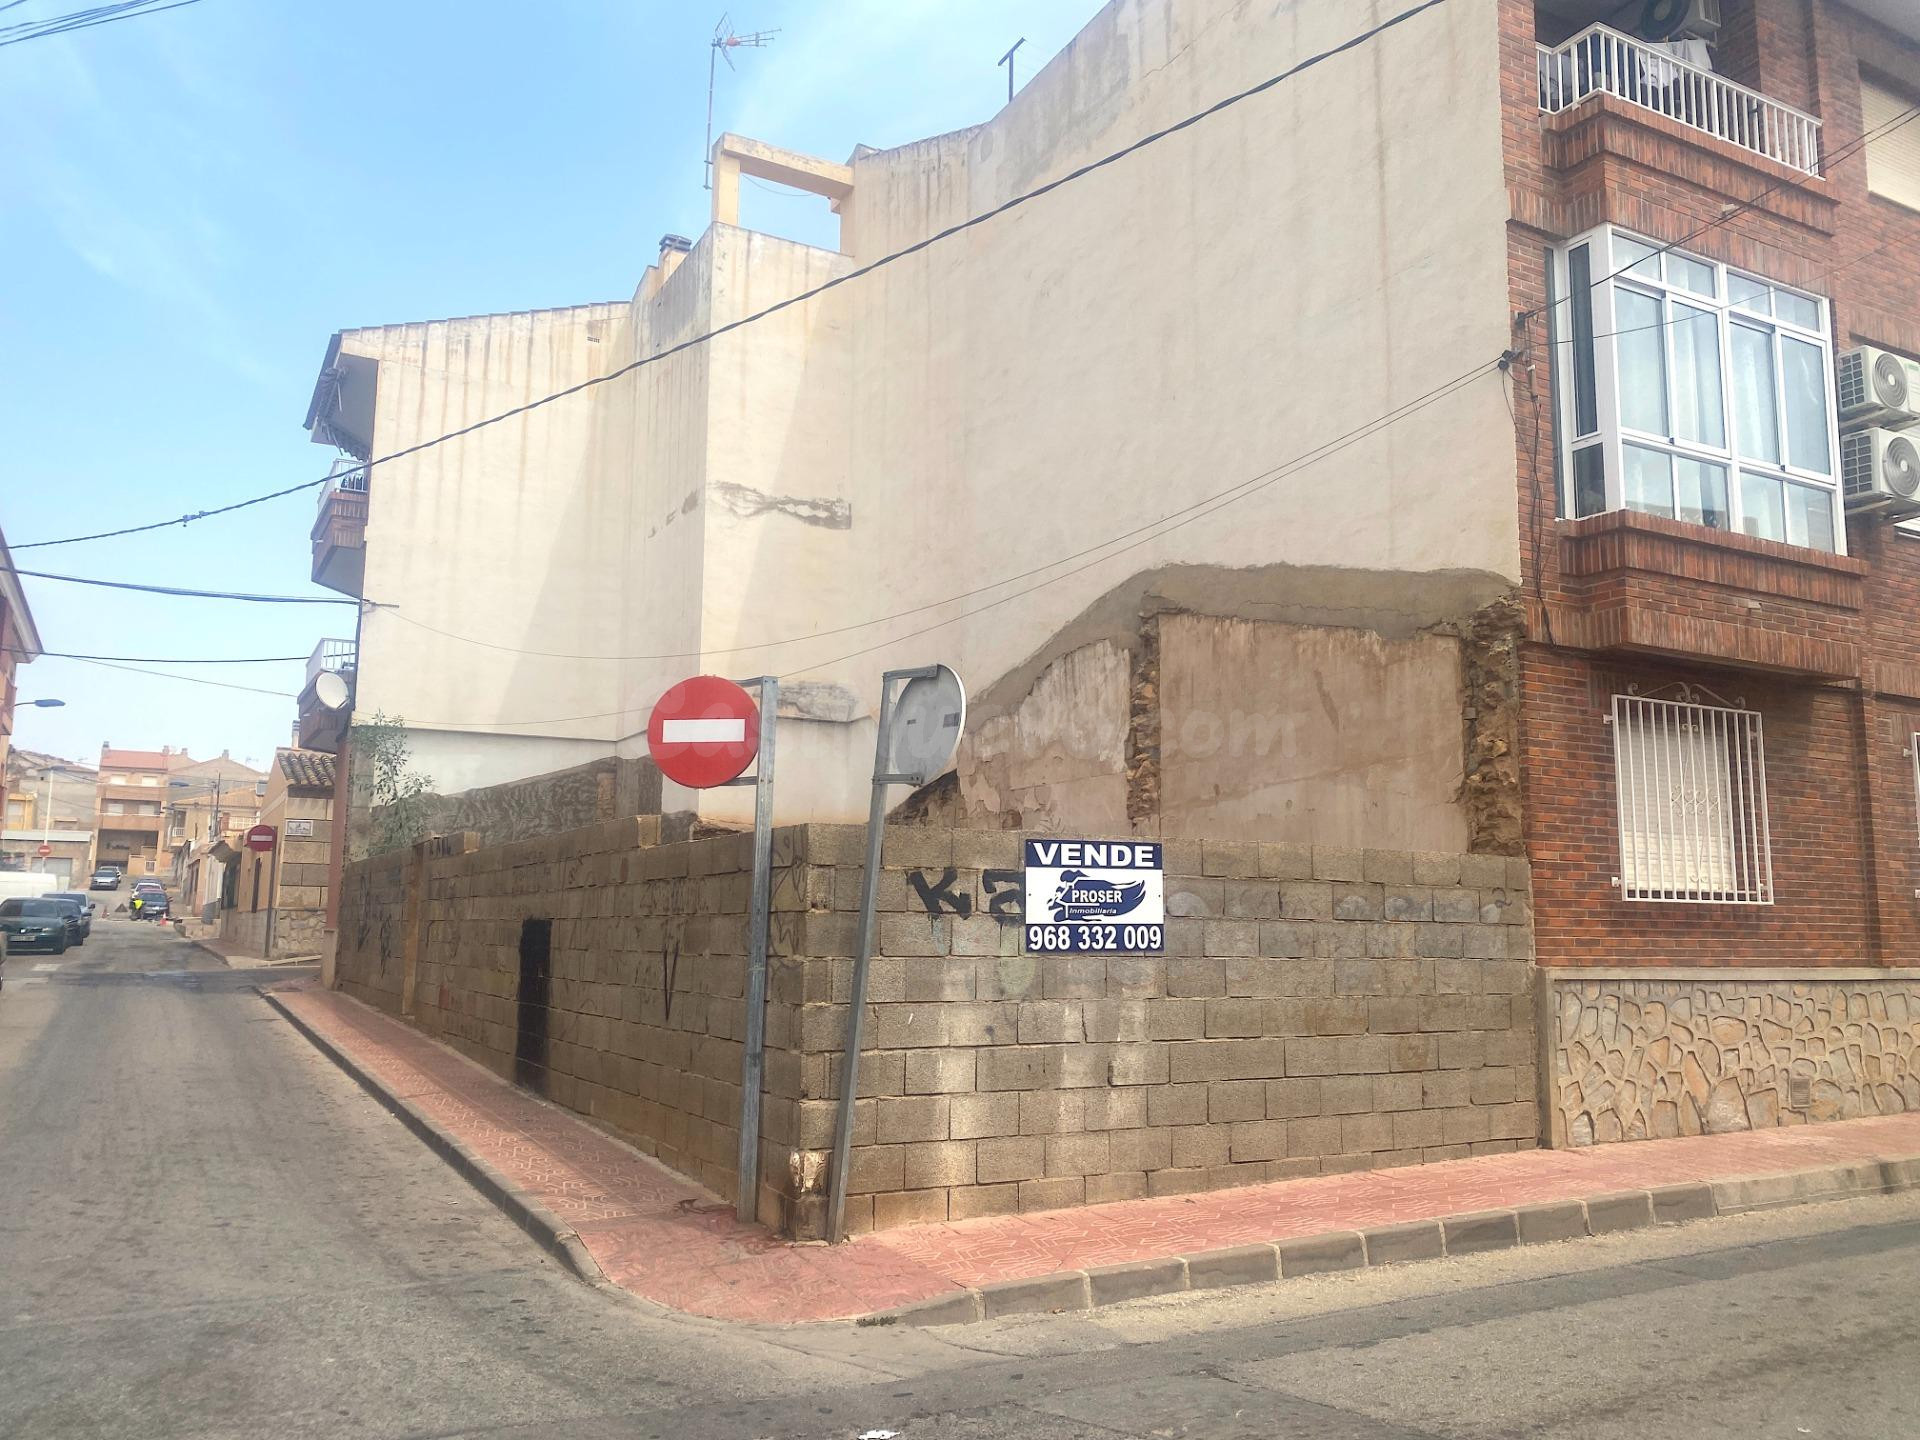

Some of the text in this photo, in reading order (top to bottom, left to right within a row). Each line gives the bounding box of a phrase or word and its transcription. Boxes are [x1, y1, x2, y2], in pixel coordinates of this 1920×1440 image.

[1033, 842, 1154, 868] VENDE
[1071, 890, 1123, 903] PROSER
[1069, 907, 1117, 915] Inmobiliaria
[1029, 926, 1161, 950] 968 332 009
